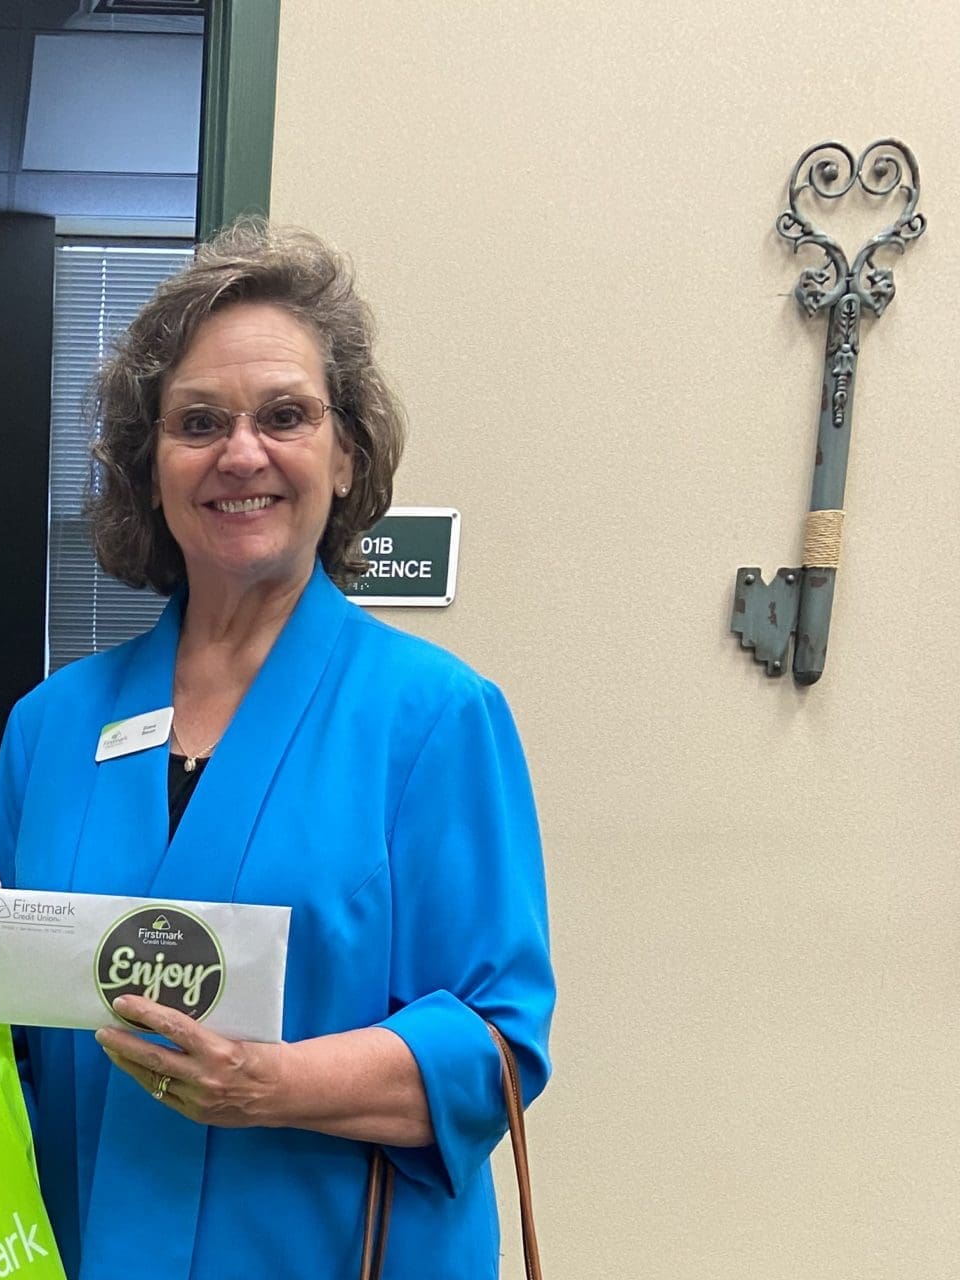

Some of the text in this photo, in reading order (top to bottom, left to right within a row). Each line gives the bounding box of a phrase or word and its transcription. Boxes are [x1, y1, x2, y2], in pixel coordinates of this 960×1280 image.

[361, 560, 432, 578] RENCE
[13, 898, 75, 916] Firstmark
[13, 911, 35, 921] Credit
[138, 928, 184, 940] Firstmark
[100, 947, 221, 1006] Enjoy
